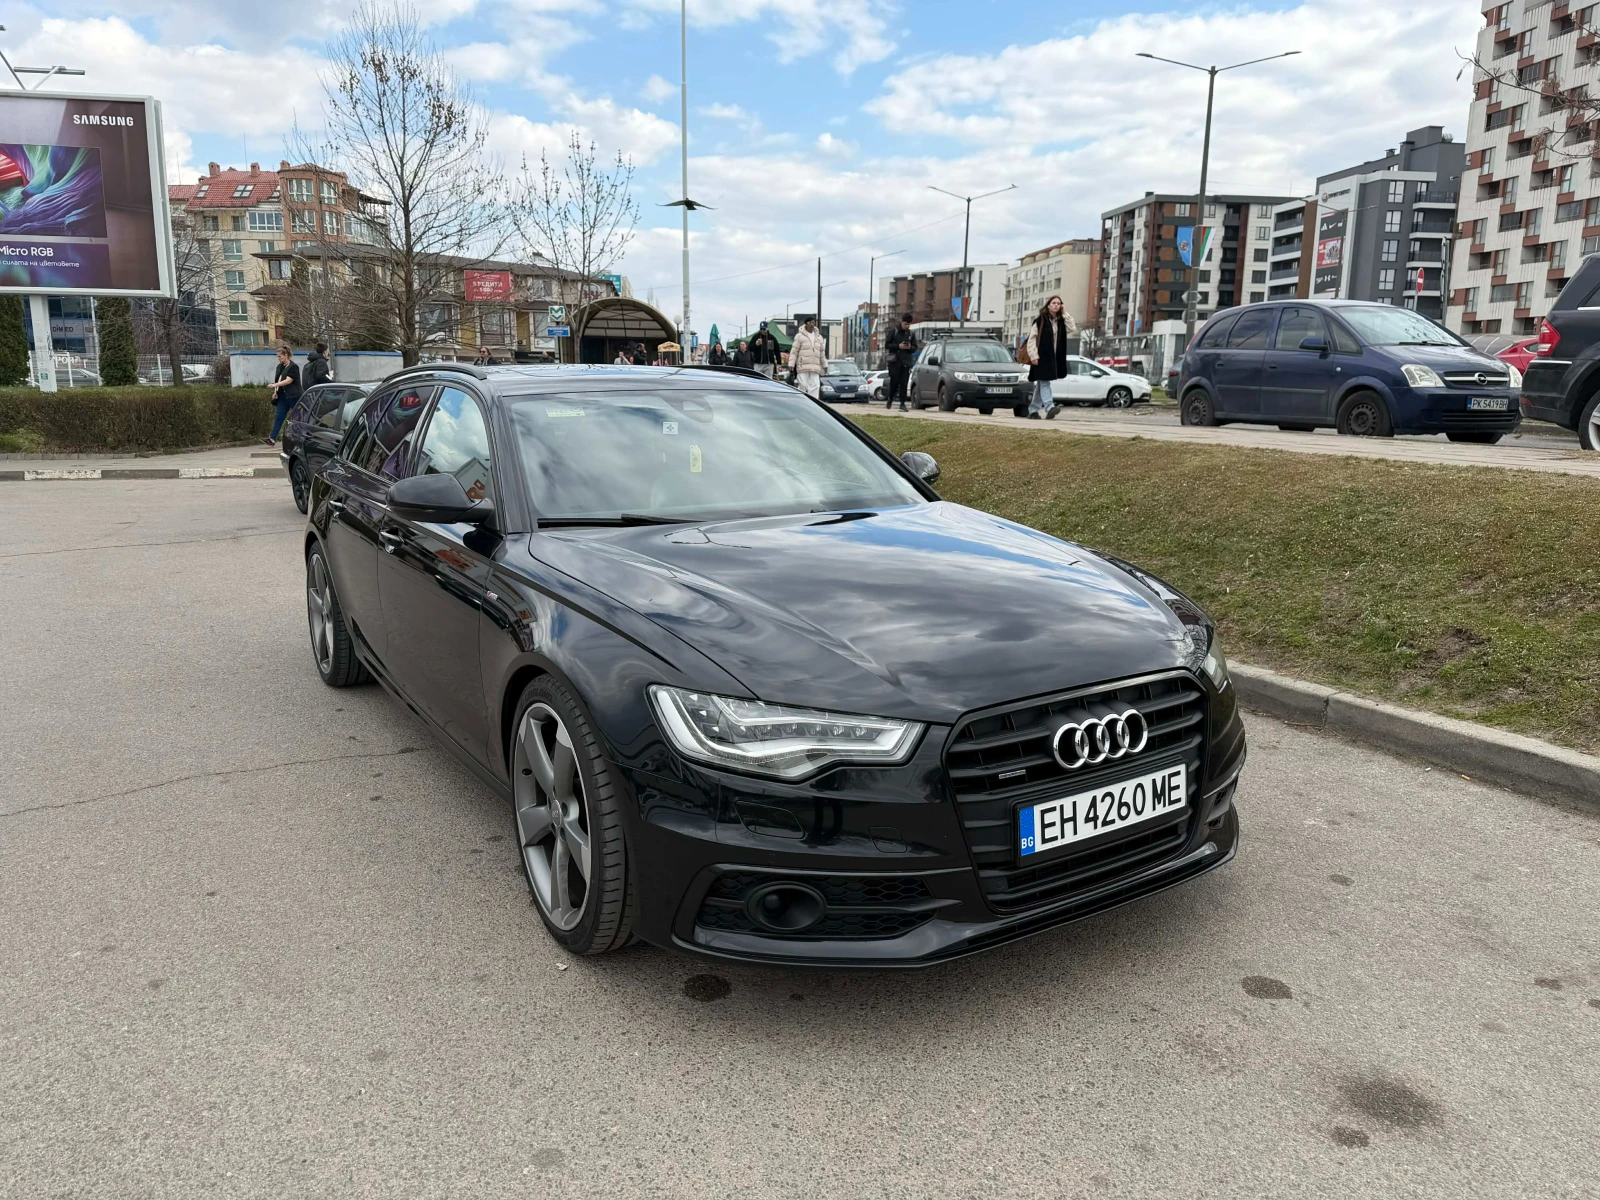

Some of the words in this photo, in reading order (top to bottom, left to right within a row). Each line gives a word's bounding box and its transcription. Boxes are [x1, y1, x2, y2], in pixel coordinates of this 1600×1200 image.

[73, 114, 134, 126] SAMSUNG
[30, 247, 54, 257] RGB
[1040, 800, 1078, 845] EH
[1084, 782, 1147, 830] 4260
[1151, 770, 1182, 812] ME
[1021, 836, 1034, 849] BG
